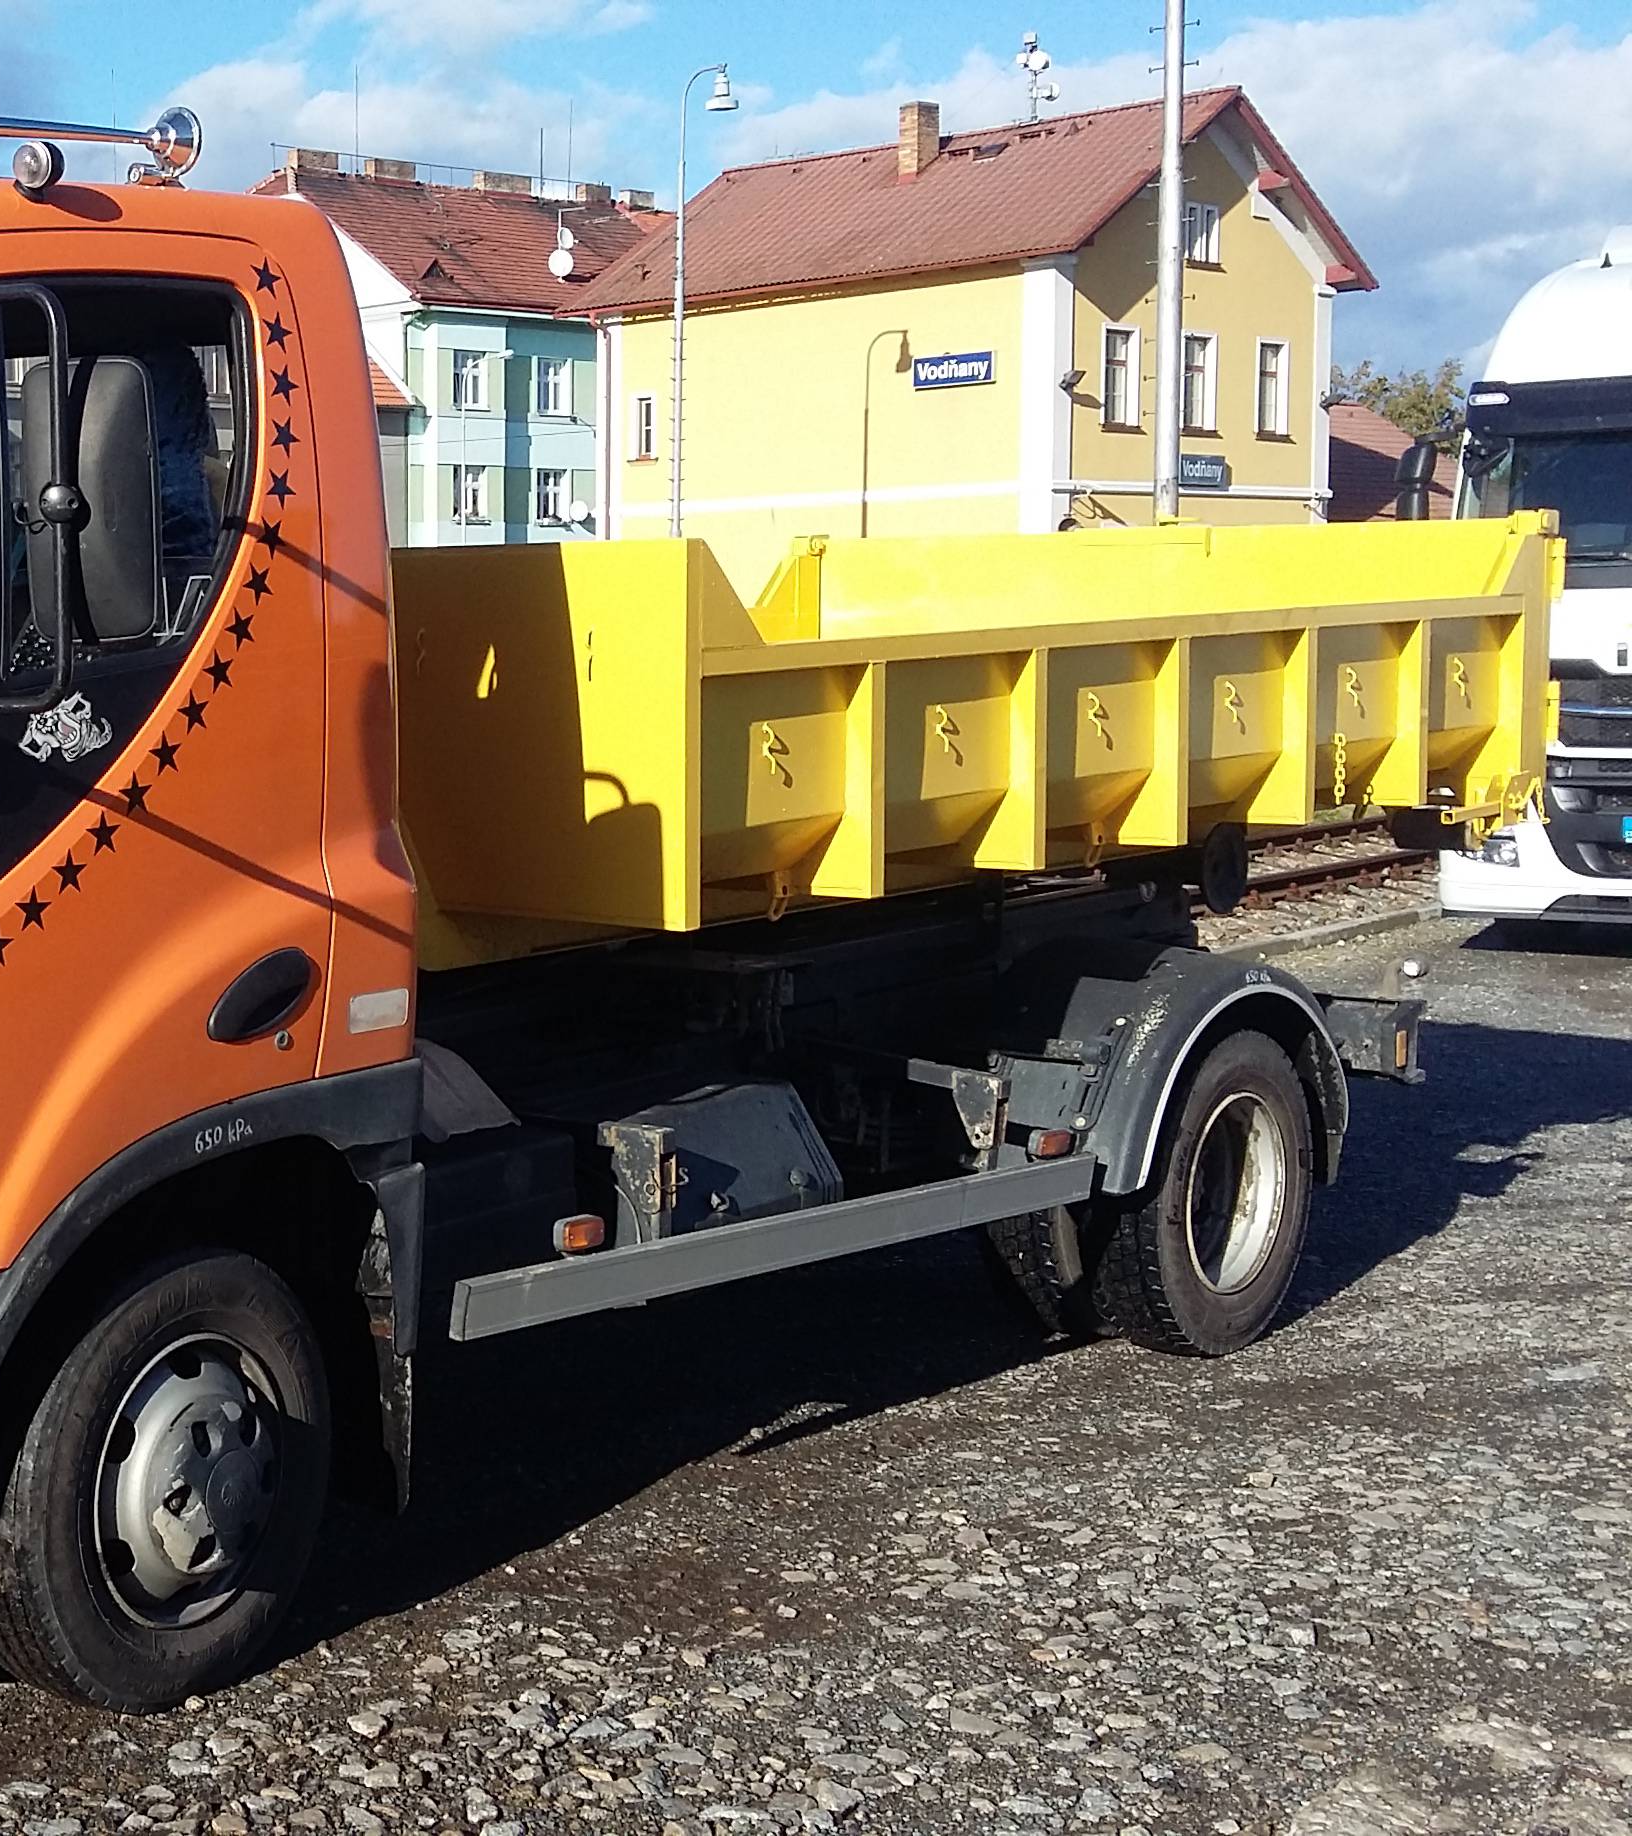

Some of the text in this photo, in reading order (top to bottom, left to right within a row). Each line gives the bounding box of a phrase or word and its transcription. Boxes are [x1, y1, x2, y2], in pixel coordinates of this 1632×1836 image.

[916, 359, 989, 381] Vodňany
[1182, 459, 1224, 482] Vodňany
[195, 1118, 254, 1154] 650 kPa
